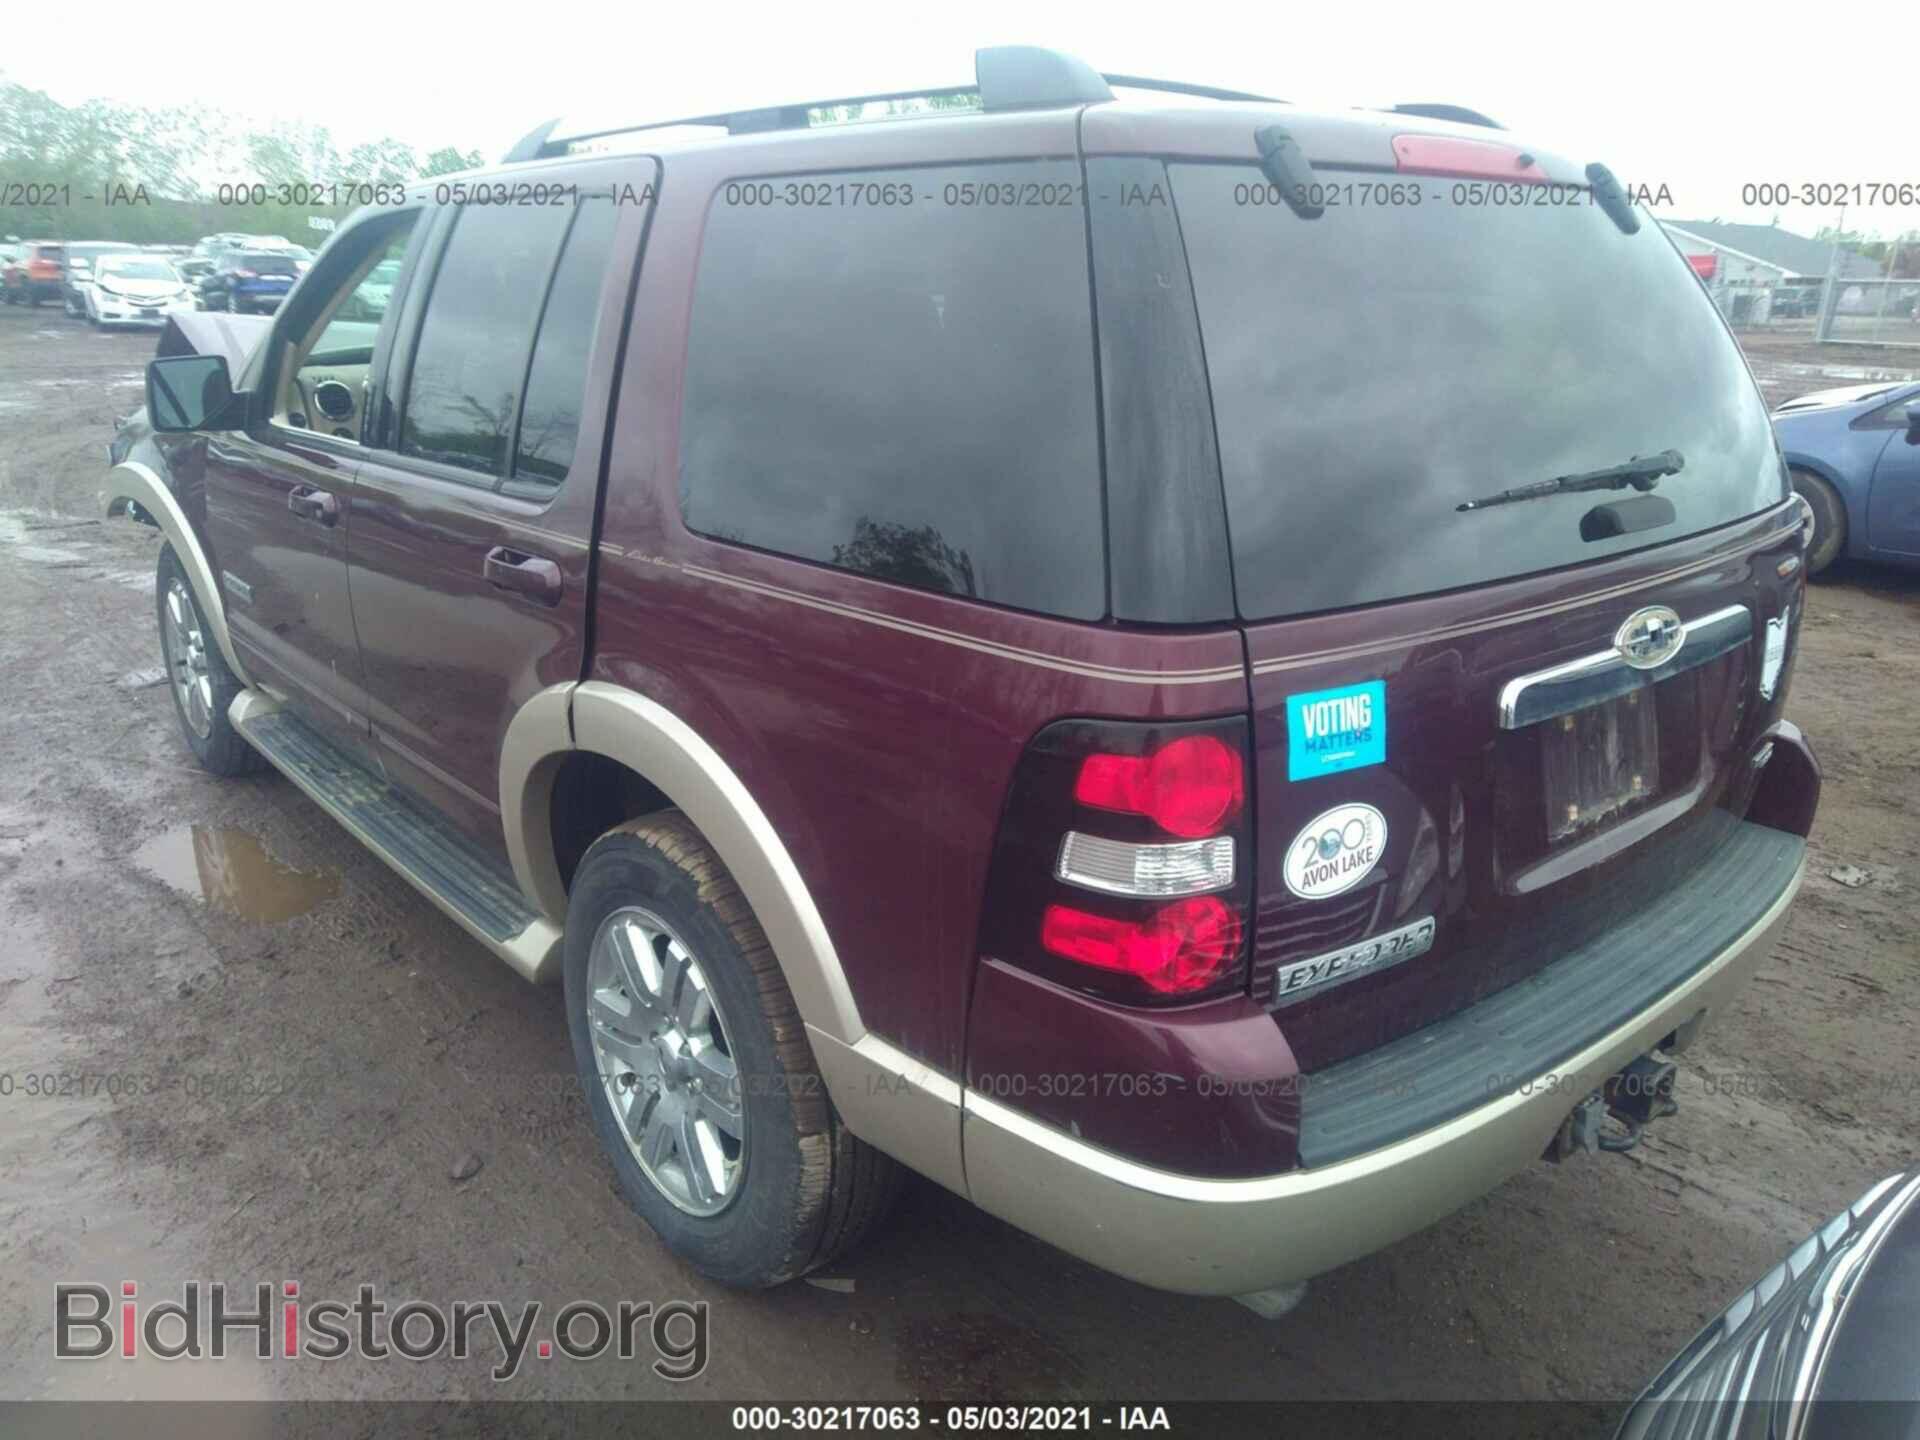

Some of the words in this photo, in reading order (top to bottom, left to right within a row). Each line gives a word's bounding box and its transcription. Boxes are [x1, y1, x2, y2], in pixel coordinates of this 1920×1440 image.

[1302, 692, 1371, 738] VOTING
[1305, 728, 1372, 754] MATTERS
[1302, 818, 1366, 868] 200
[1302, 860, 1339, 890] AVON
[1342, 845, 1374, 872] LAKE
